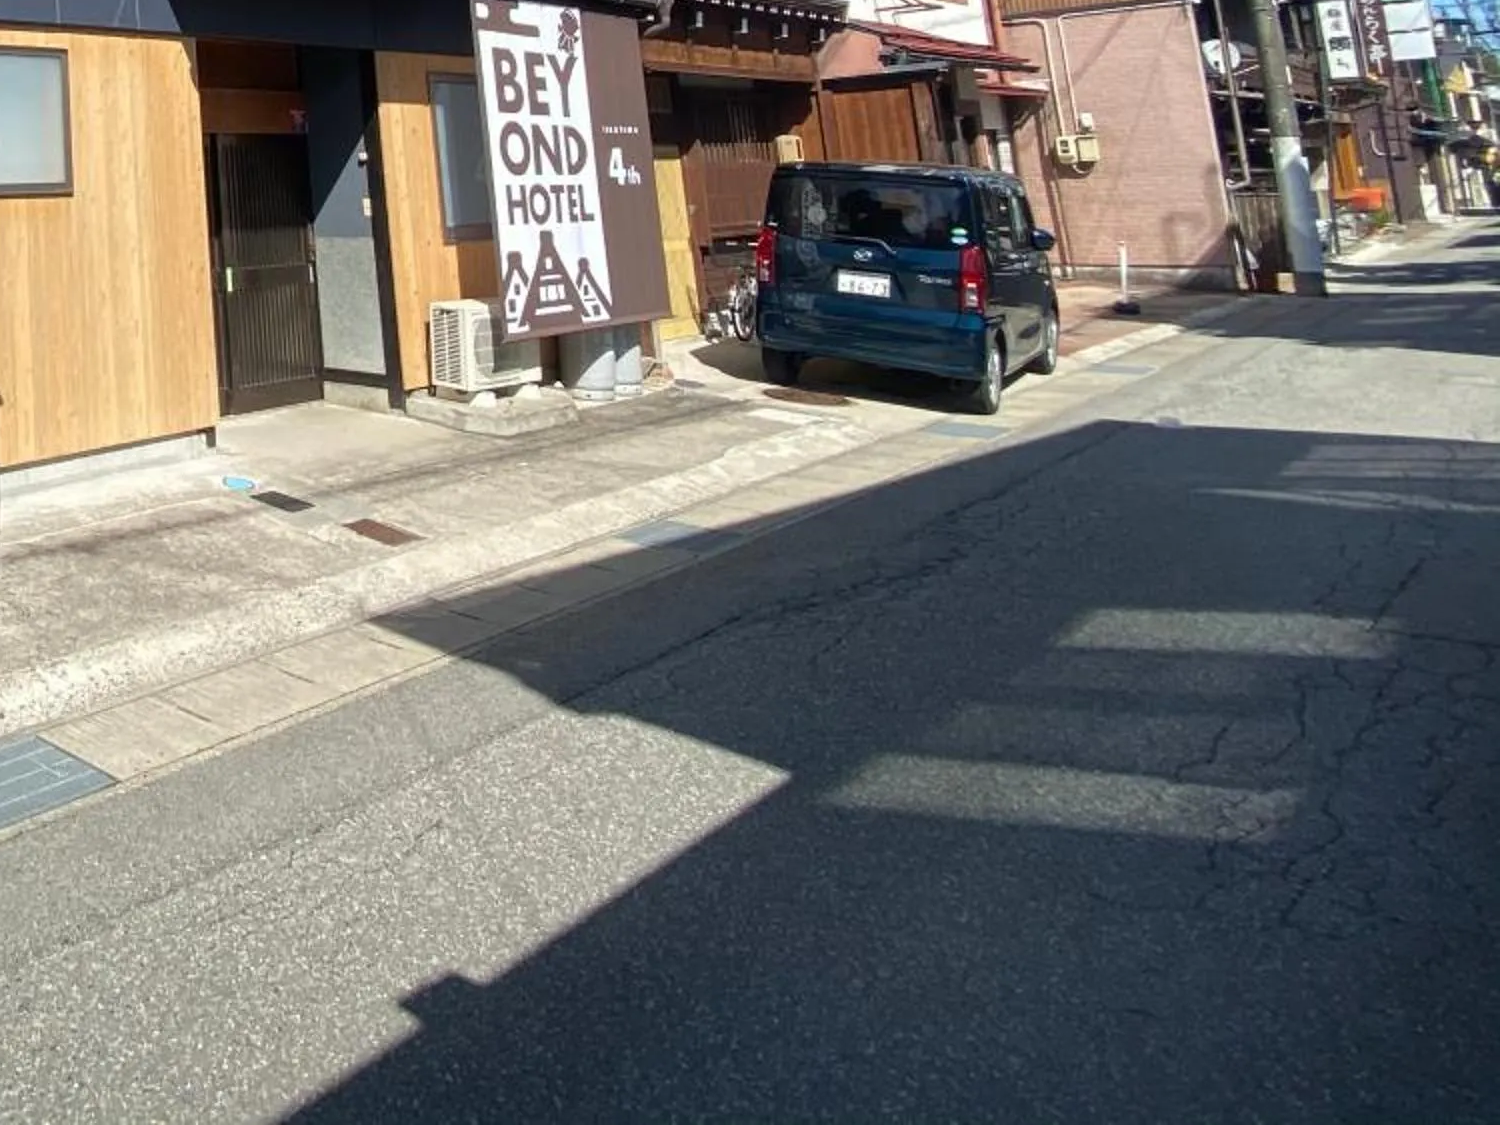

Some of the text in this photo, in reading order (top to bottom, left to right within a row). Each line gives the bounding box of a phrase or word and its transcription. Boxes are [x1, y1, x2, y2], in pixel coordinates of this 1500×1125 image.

[492, 47, 578, 117] BEY
[500, 121, 587, 176] OND
[609, 146, 641, 185] 4th
[506, 183, 595, 225] HOTEL
